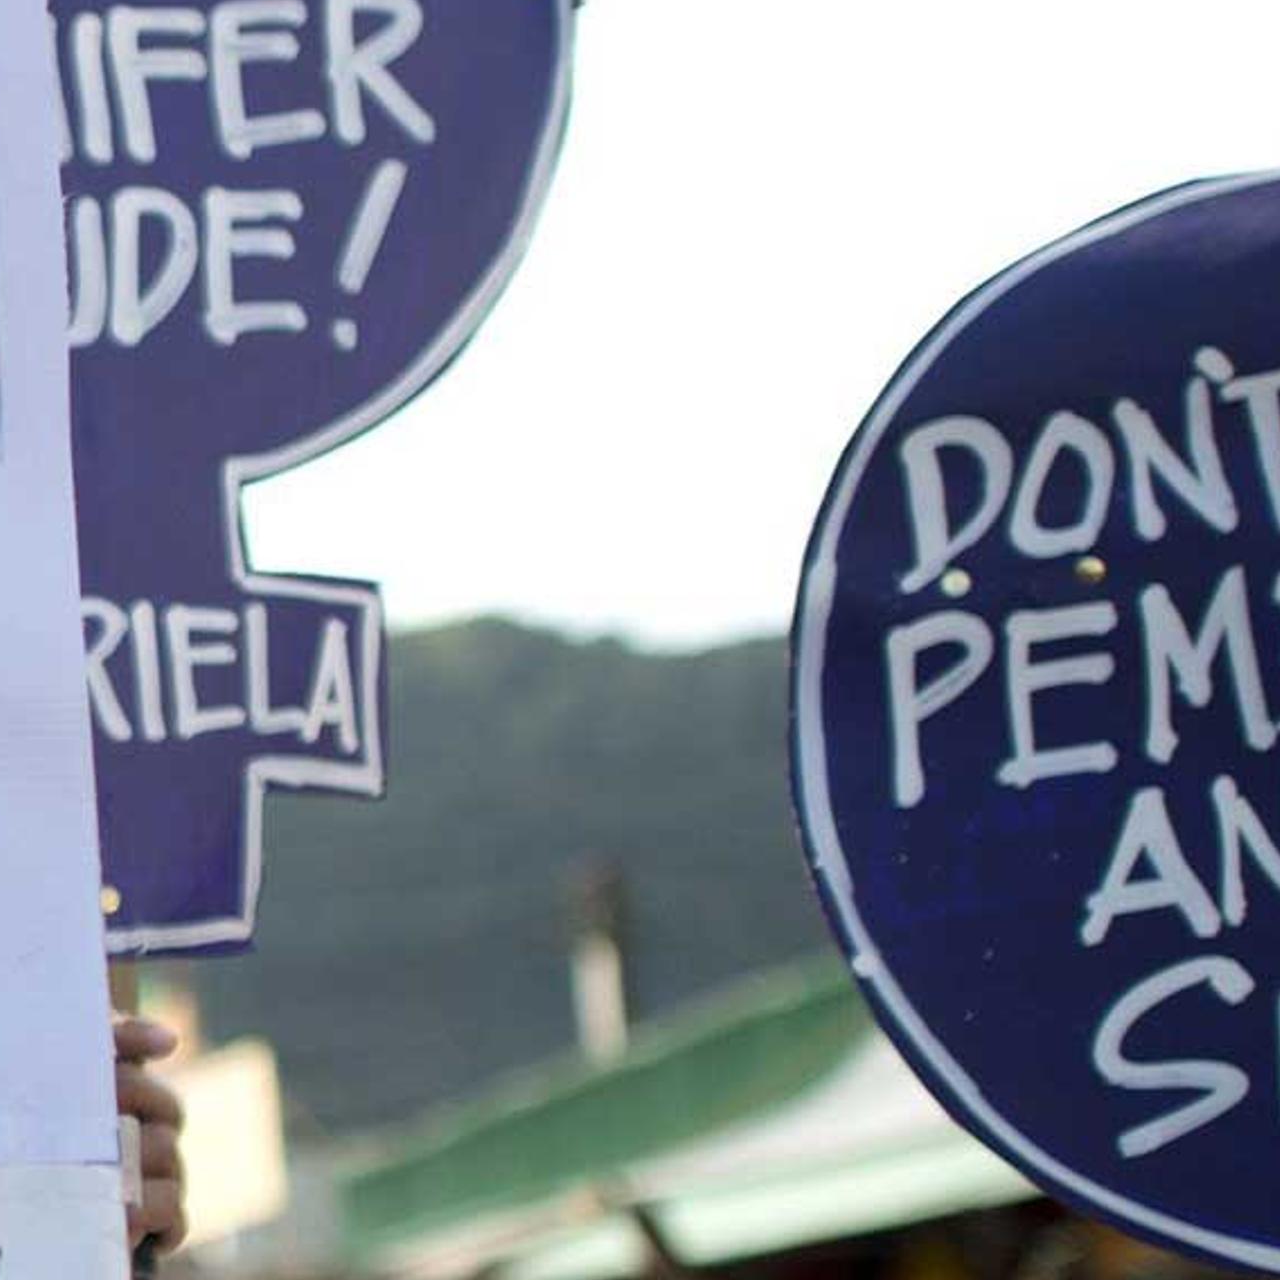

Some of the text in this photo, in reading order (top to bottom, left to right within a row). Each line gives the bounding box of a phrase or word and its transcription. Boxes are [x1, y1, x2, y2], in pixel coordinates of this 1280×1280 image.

[81, 595, 358, 754] RIELA
[887, 565, 1280, 807] PEM
[1094, 955, 1280, 1158] S
